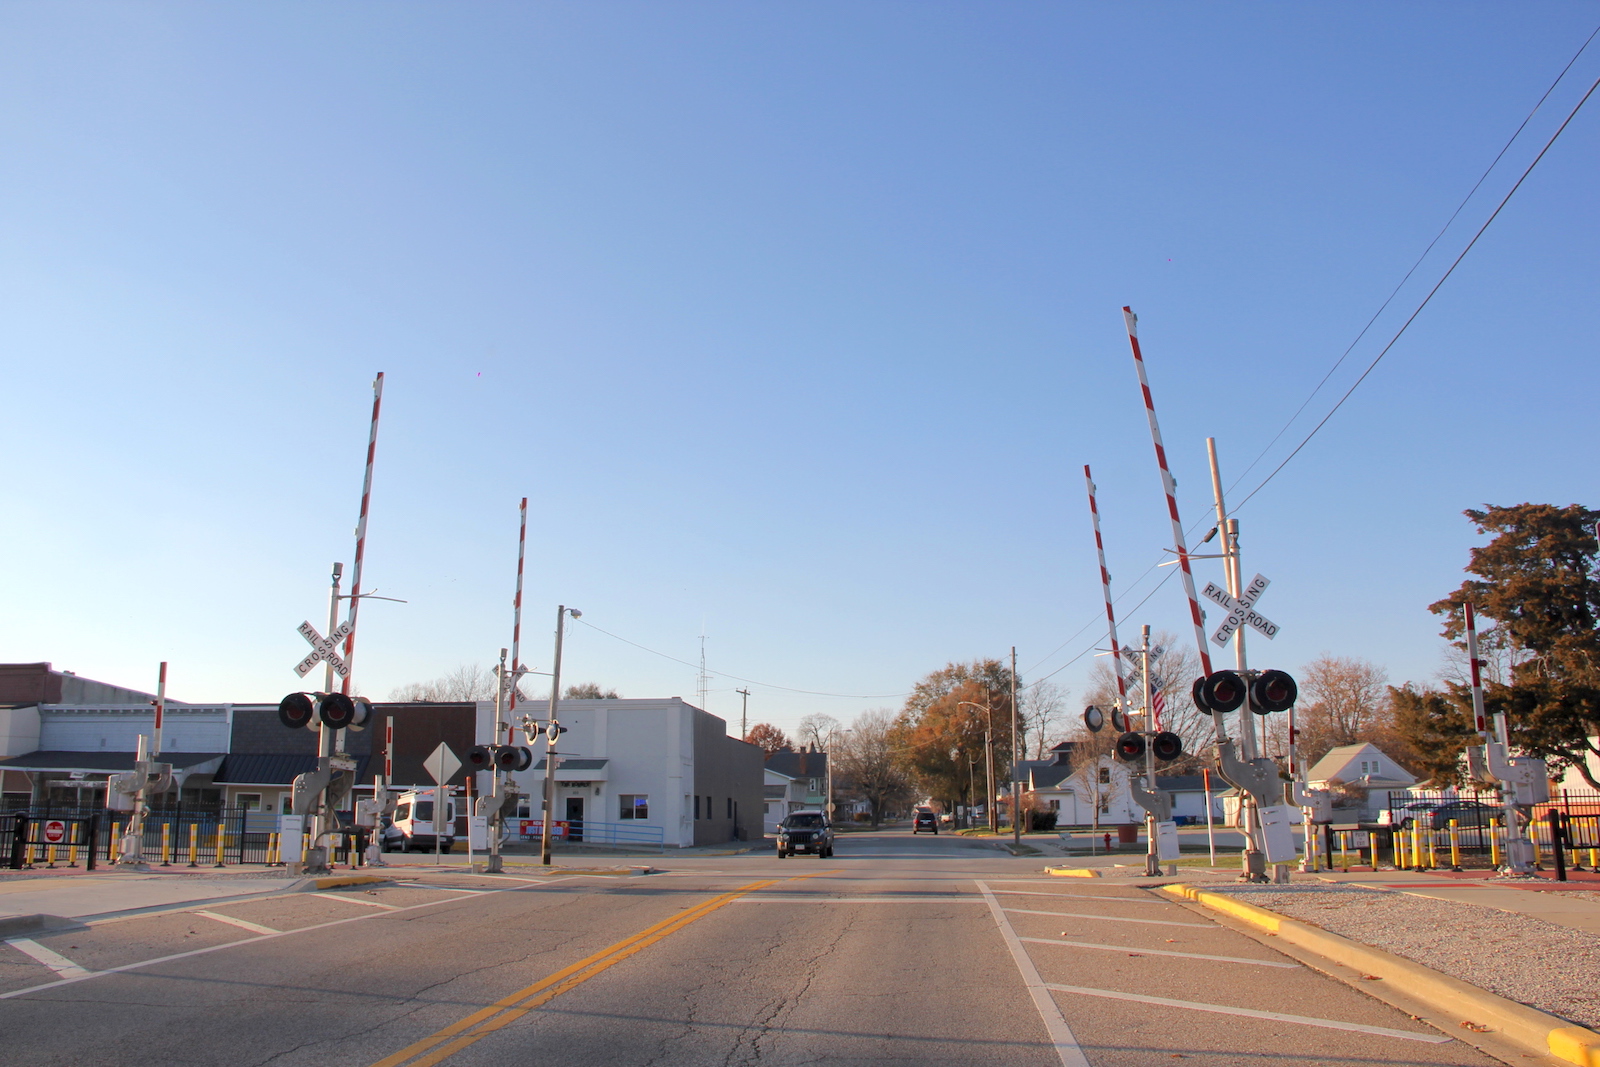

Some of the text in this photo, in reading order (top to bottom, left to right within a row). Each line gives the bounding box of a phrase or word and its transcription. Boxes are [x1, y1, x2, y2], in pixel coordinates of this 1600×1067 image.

[1204, 584, 1277, 636] RAIL ROAD
[1216, 578, 1265, 642] CROSSING
[298, 625, 349, 673] CROSSING
[300, 623, 348, 676] RAIL ROAD
